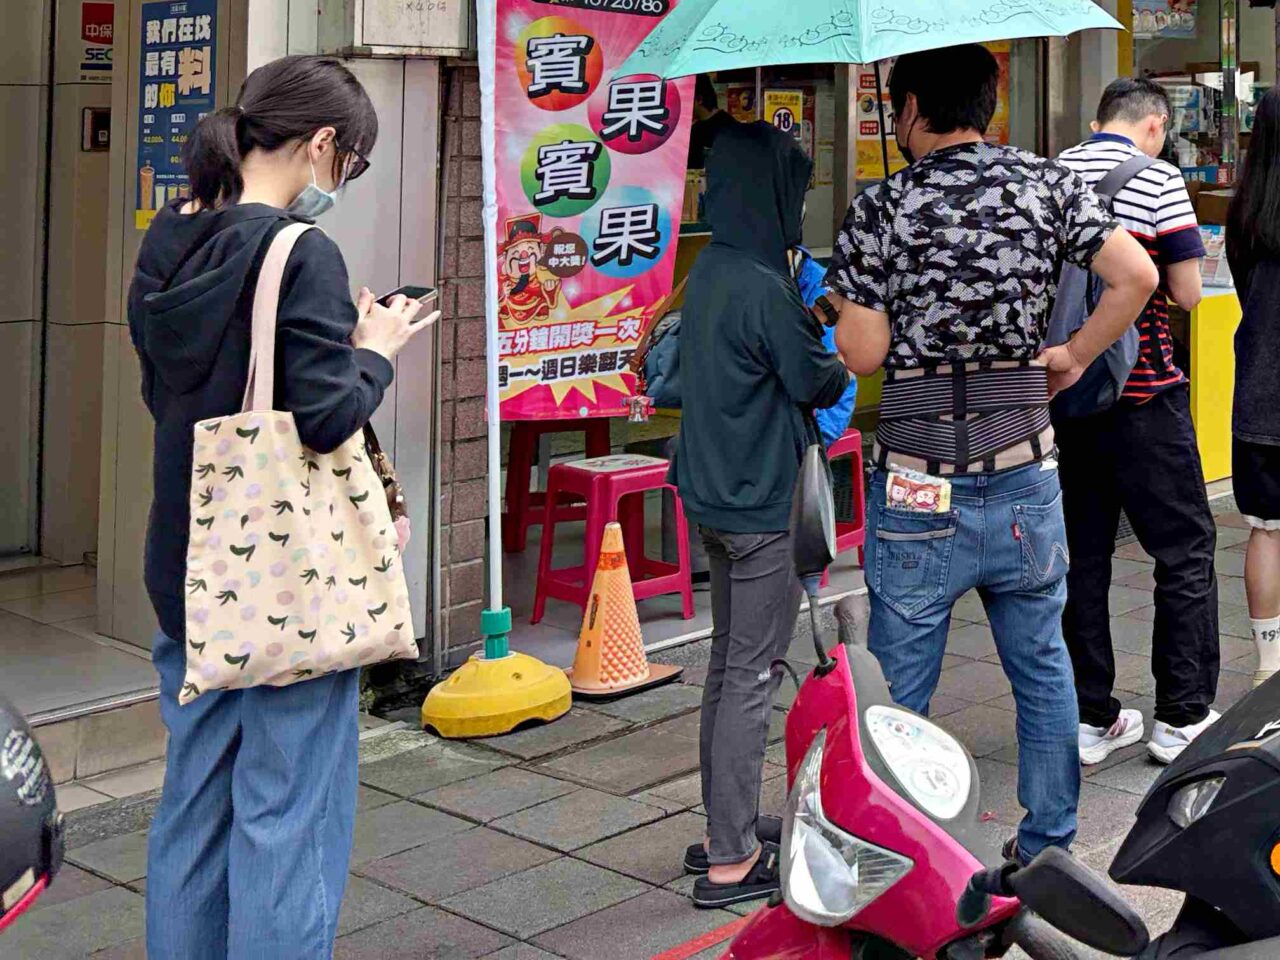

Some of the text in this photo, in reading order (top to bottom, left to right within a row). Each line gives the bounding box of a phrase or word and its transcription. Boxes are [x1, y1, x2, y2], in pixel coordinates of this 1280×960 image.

[145, 14, 212, 45] 我們在找
[144, 82, 176, 109] 的你
